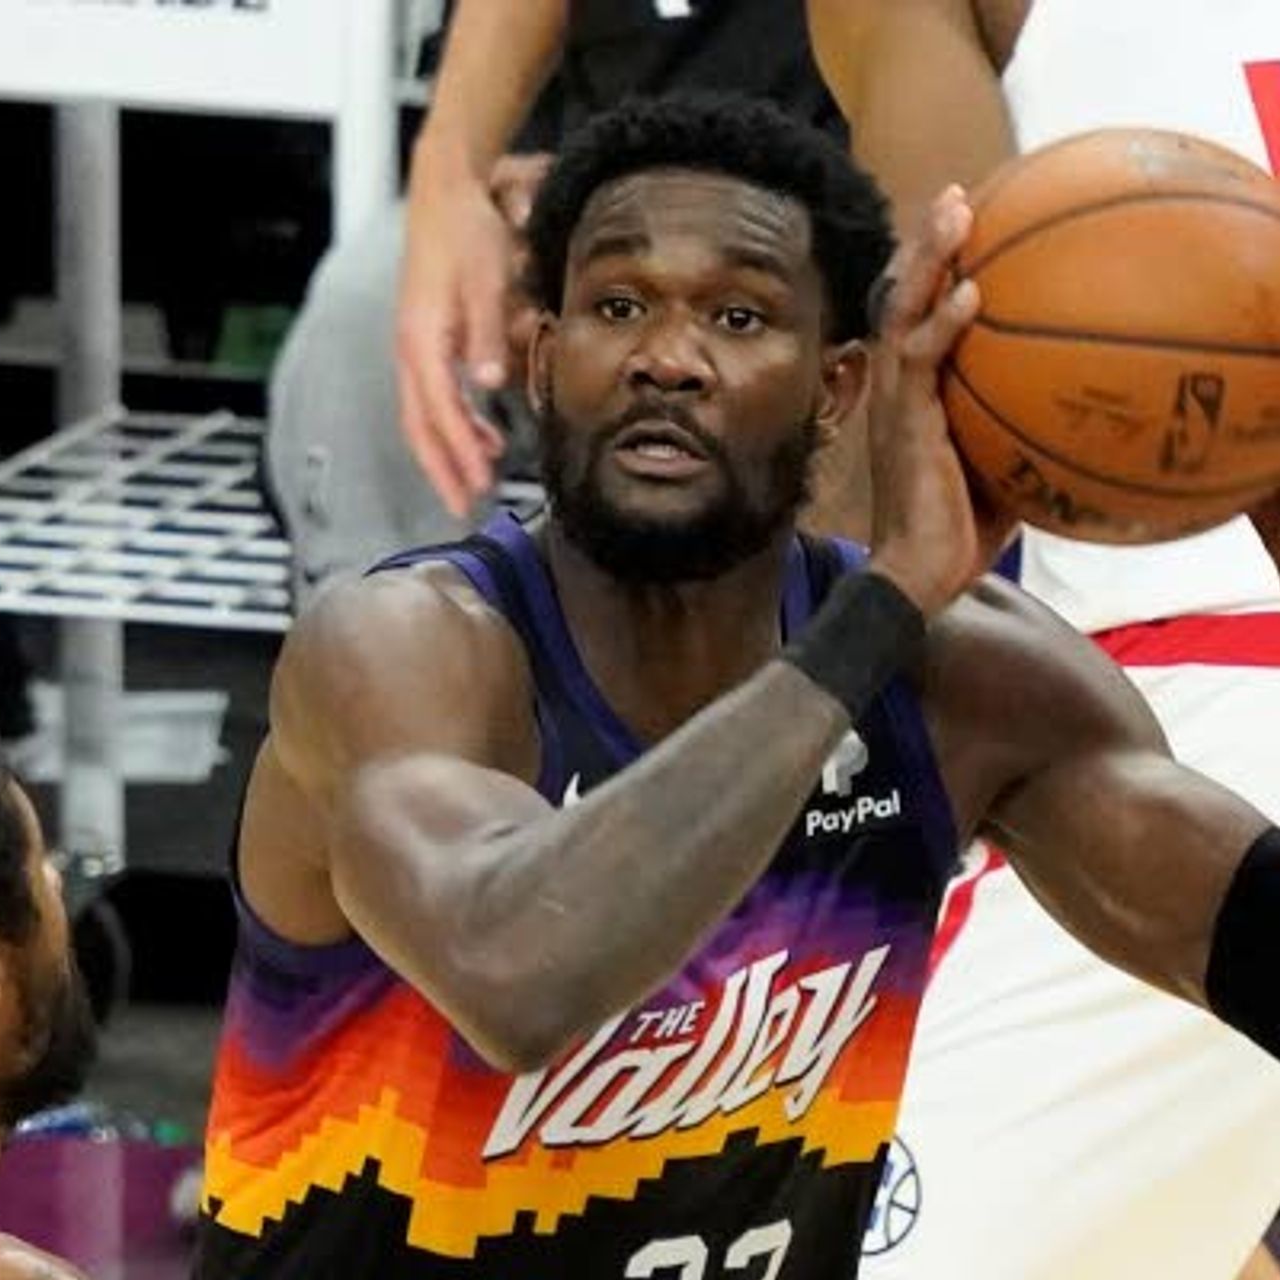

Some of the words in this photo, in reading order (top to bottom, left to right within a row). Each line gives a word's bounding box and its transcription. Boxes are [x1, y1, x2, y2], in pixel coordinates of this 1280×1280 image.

[806, 788, 901, 837] PayPal
[630, 999, 706, 1042] THE
[482, 944, 892, 1163] Valley
